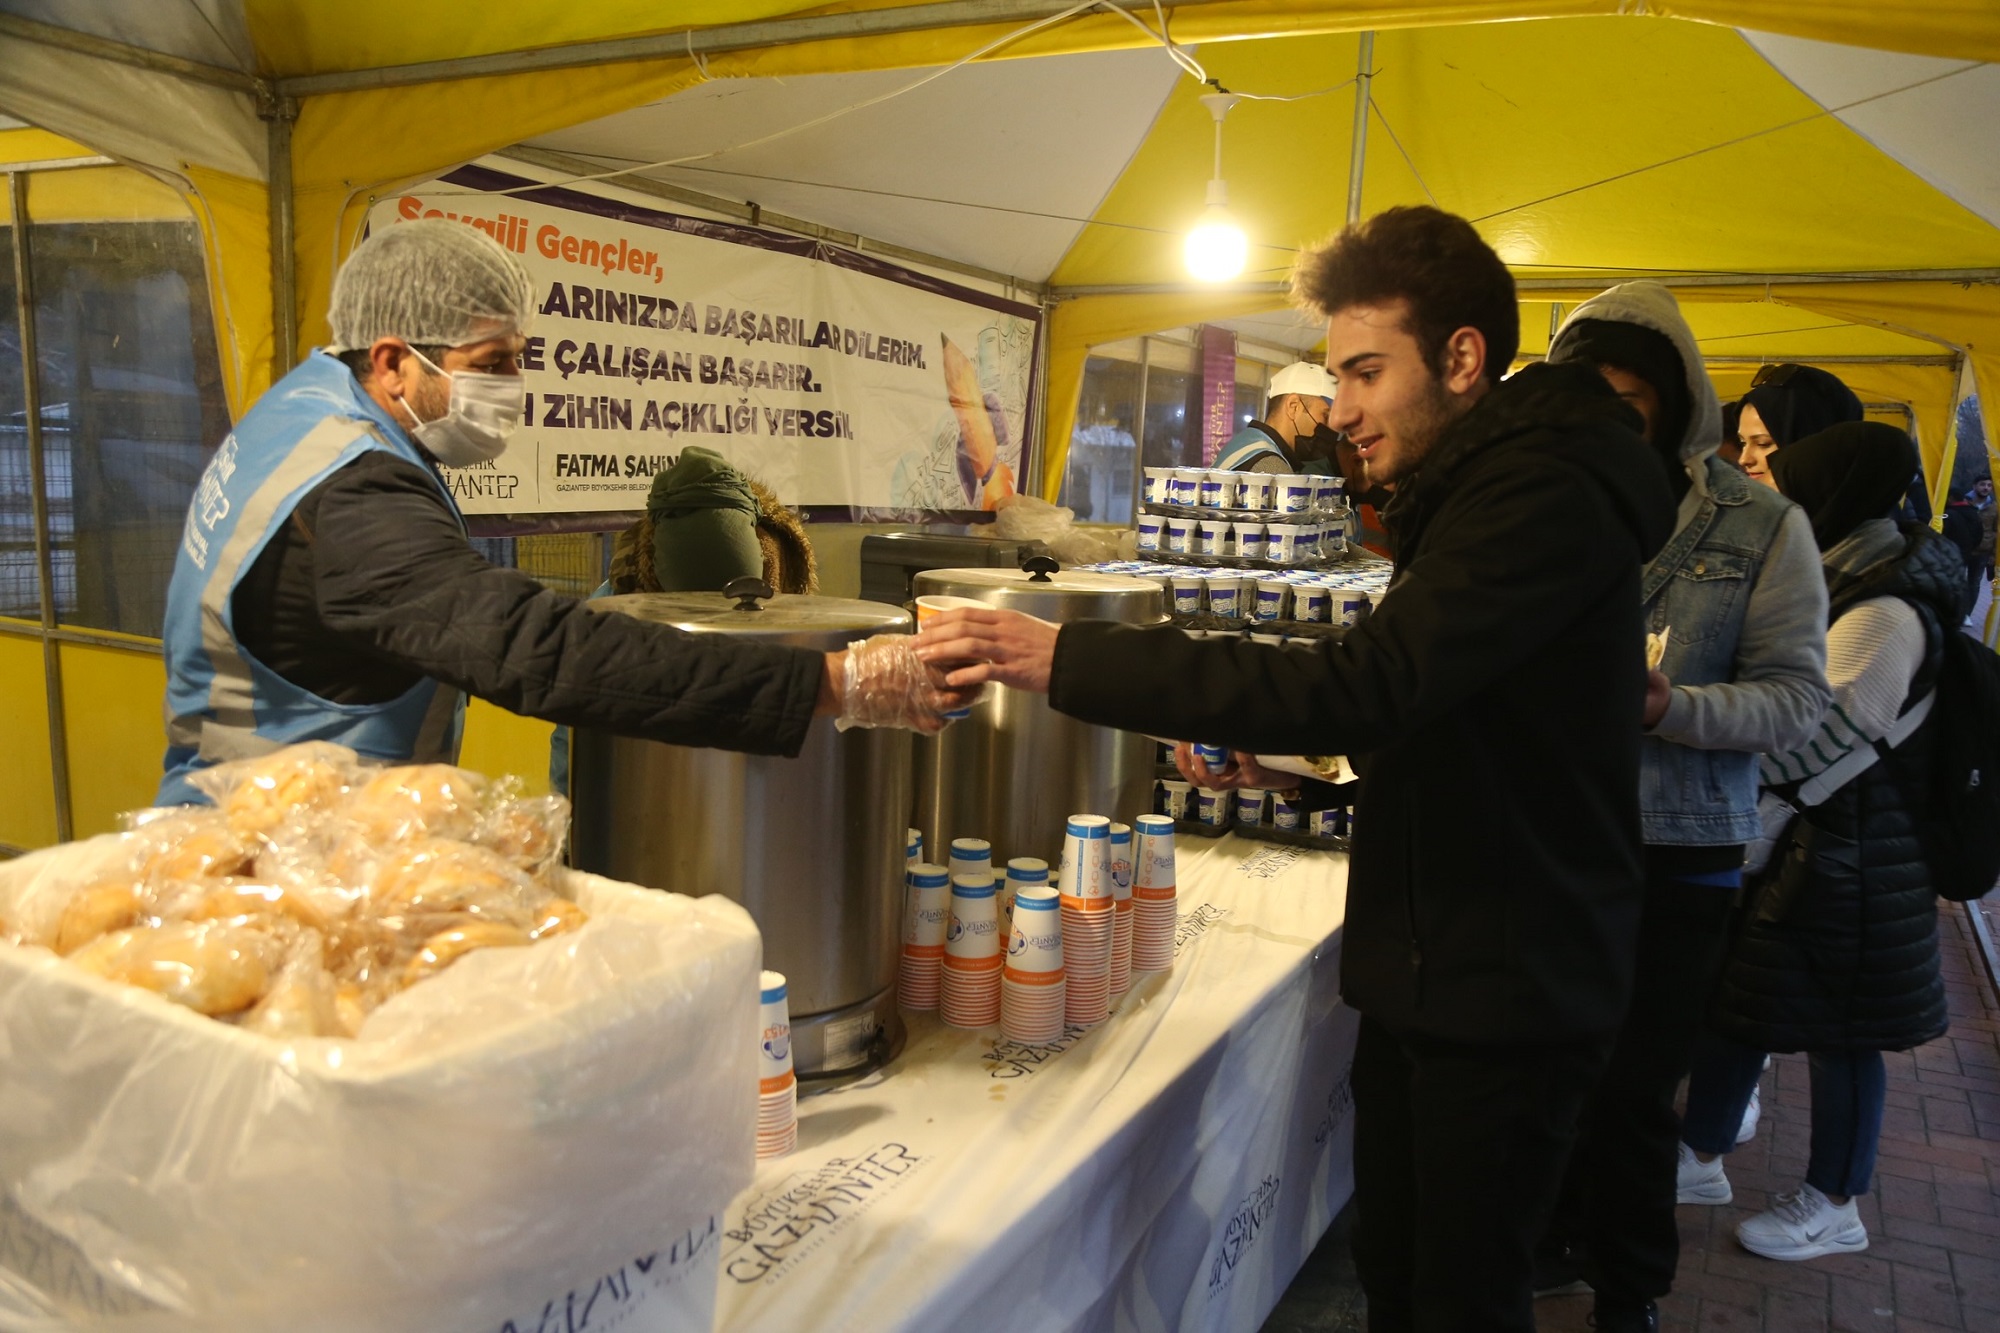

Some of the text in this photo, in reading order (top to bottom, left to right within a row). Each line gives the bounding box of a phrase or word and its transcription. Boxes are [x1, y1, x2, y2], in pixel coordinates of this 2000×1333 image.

[536, 224, 664, 284] Gençler,
[539, 282, 698, 333] ARINIZDA
[704, 305, 841, 352] BAŞARILAR
[554, 339, 693, 386] ÇALIŞAN
[700, 354, 822, 393] BAŞARIR.
[639, 397, 758, 439] AÇIKLIĞI
[556, 453, 620, 478] FATMA
